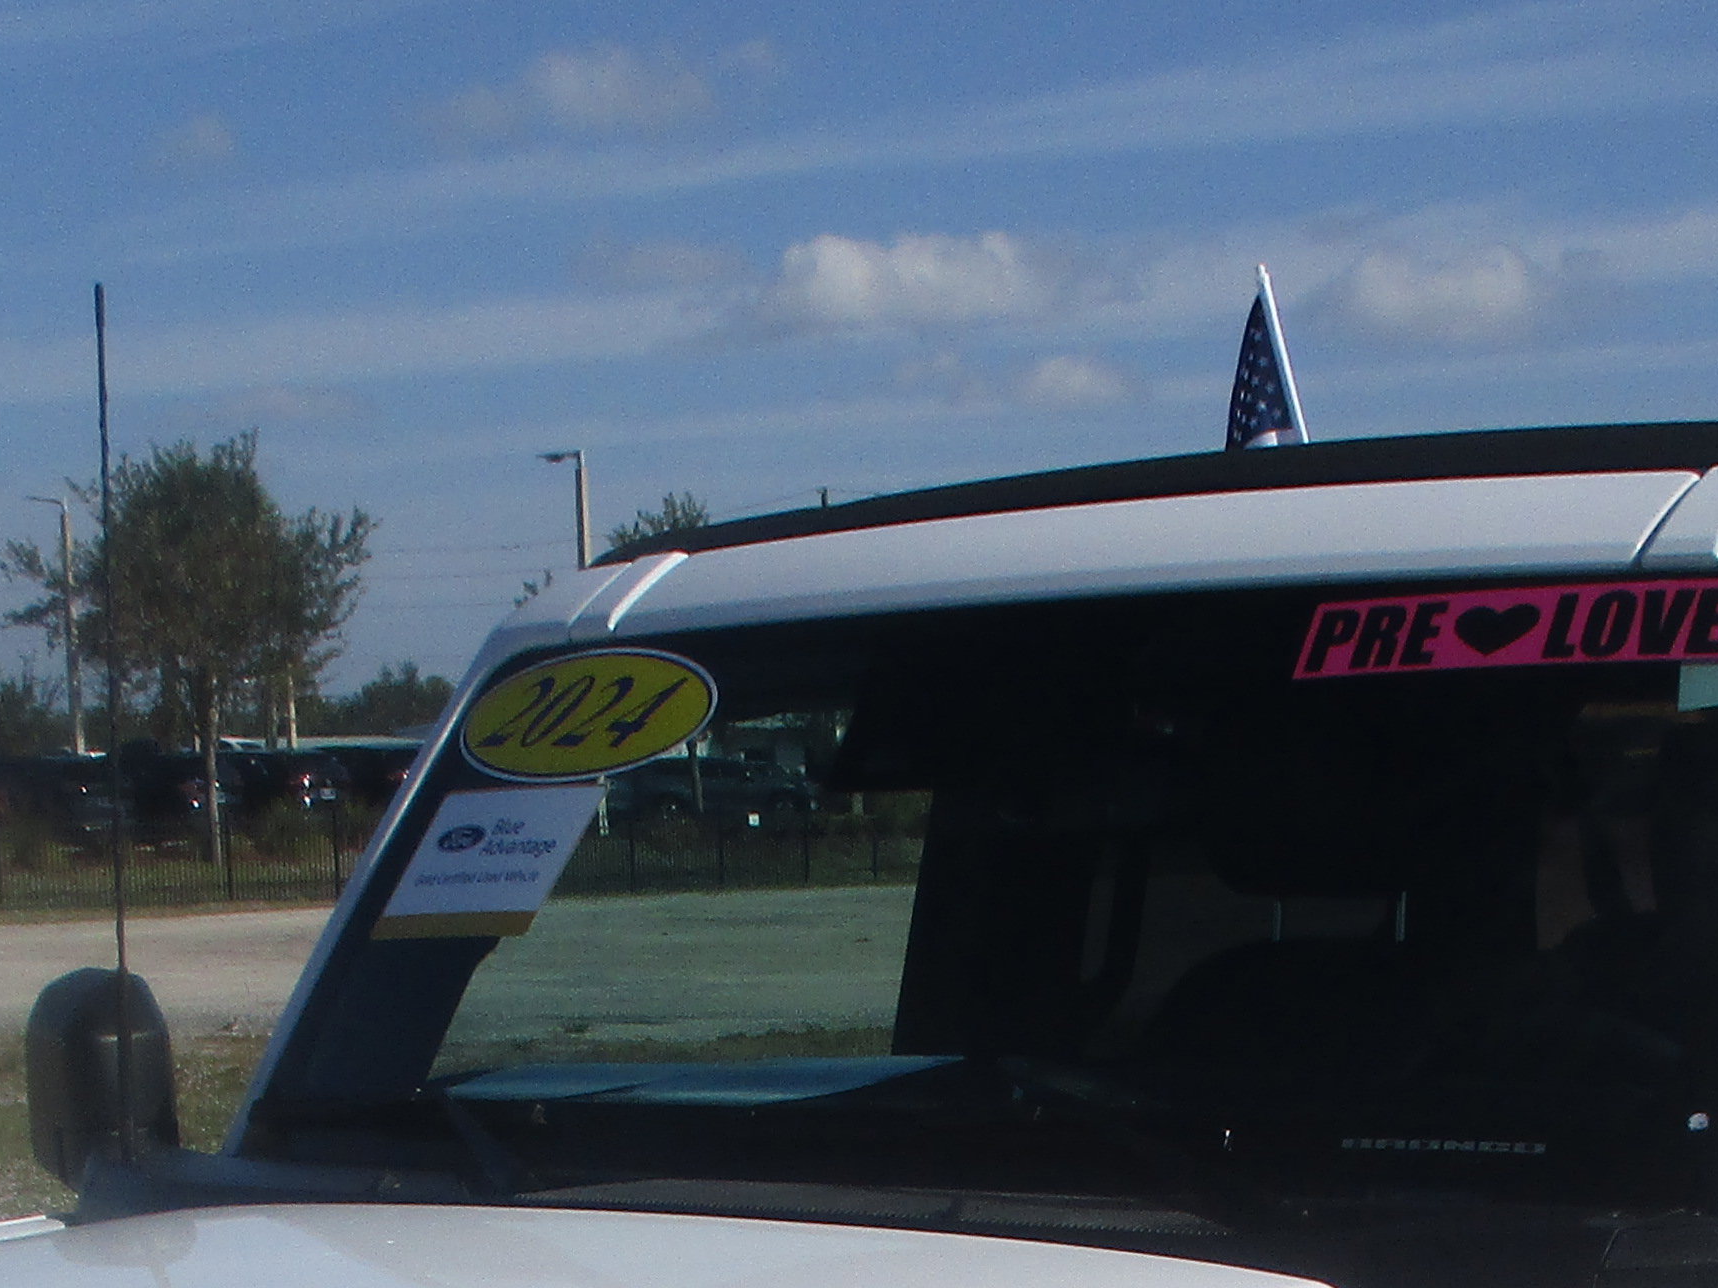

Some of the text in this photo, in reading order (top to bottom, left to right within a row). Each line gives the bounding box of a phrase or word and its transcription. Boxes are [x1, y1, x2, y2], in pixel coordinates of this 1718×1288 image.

[1302, 600, 1450, 674] PRE
[476, 673, 690, 748] 2024
[478, 838, 558, 858] Advantage
[491, 817, 525, 836] Blue
